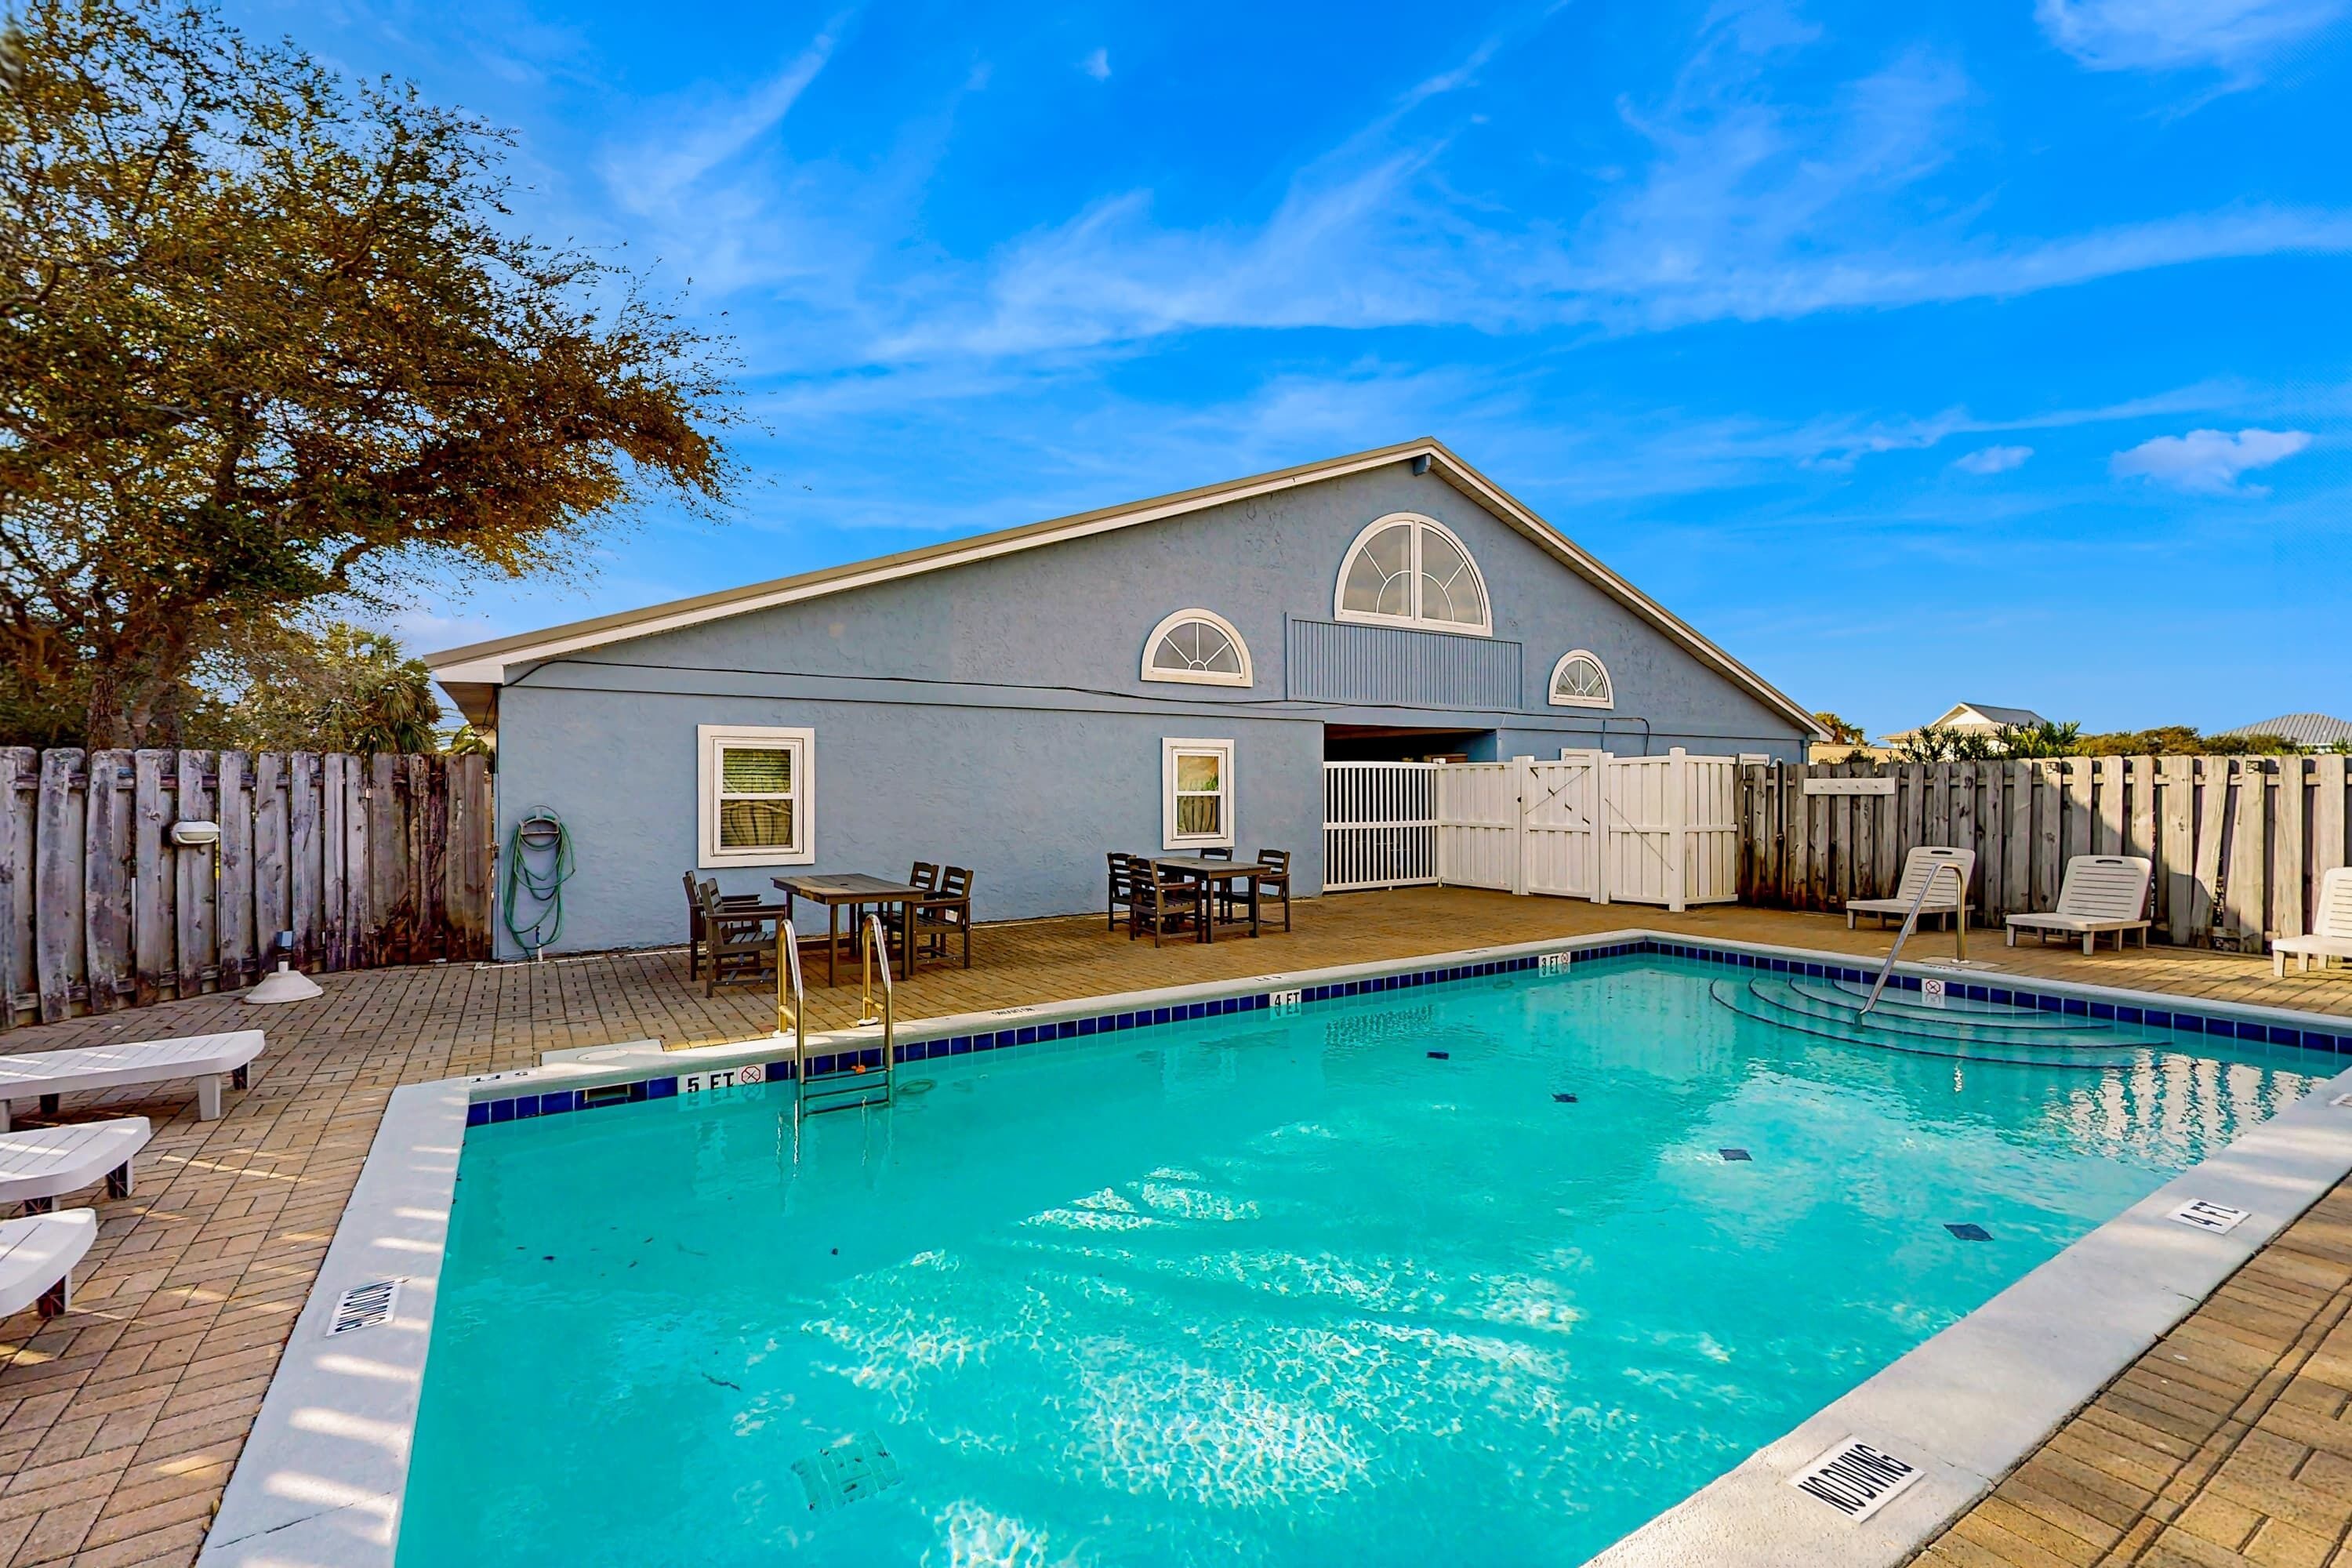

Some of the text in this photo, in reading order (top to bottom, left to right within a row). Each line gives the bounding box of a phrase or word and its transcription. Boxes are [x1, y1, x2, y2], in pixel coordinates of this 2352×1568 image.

[1274, 992, 1300, 1007] 4 FT
[688, 1072, 735, 1094] 5 FT
[2180, 1201, 2240, 1226] 4 FT
[335, 1280, 395, 1333] NO DIVING
[1797, 1443, 1915, 1515] NO DIVING
